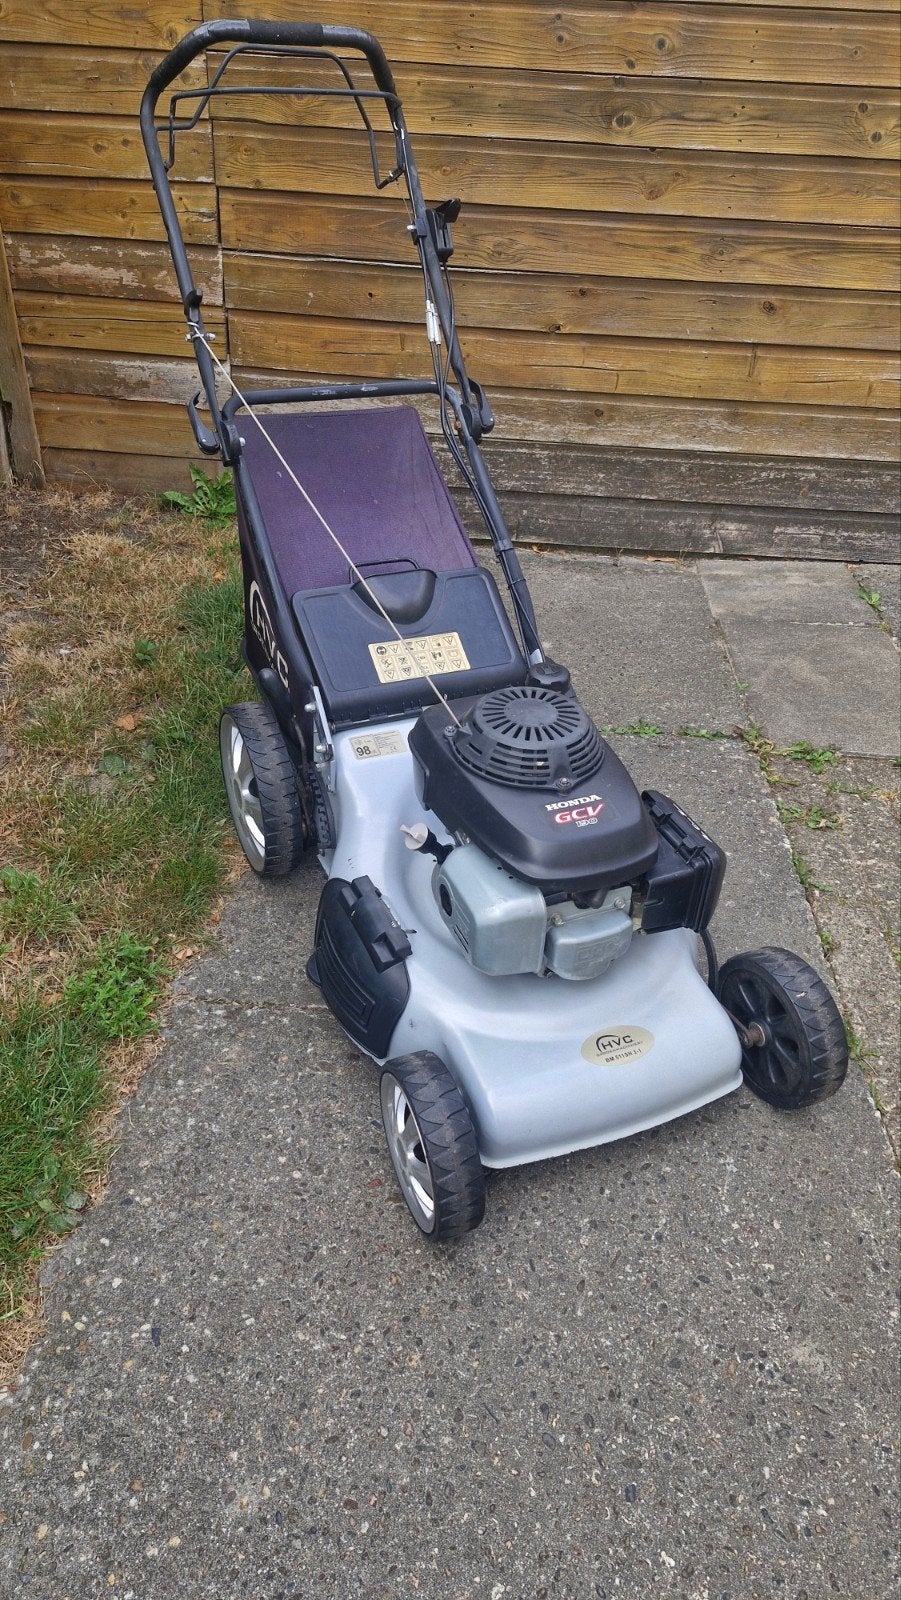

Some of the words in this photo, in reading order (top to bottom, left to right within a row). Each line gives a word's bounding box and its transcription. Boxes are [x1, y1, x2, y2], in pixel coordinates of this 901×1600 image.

[255, 599, 289, 688] HVC
[356, 745, 371, 757] 98
[545, 794, 603, 811] HONDA
[554, 803, 606, 824] GCV
[600, 1034, 633, 1050] HVC
